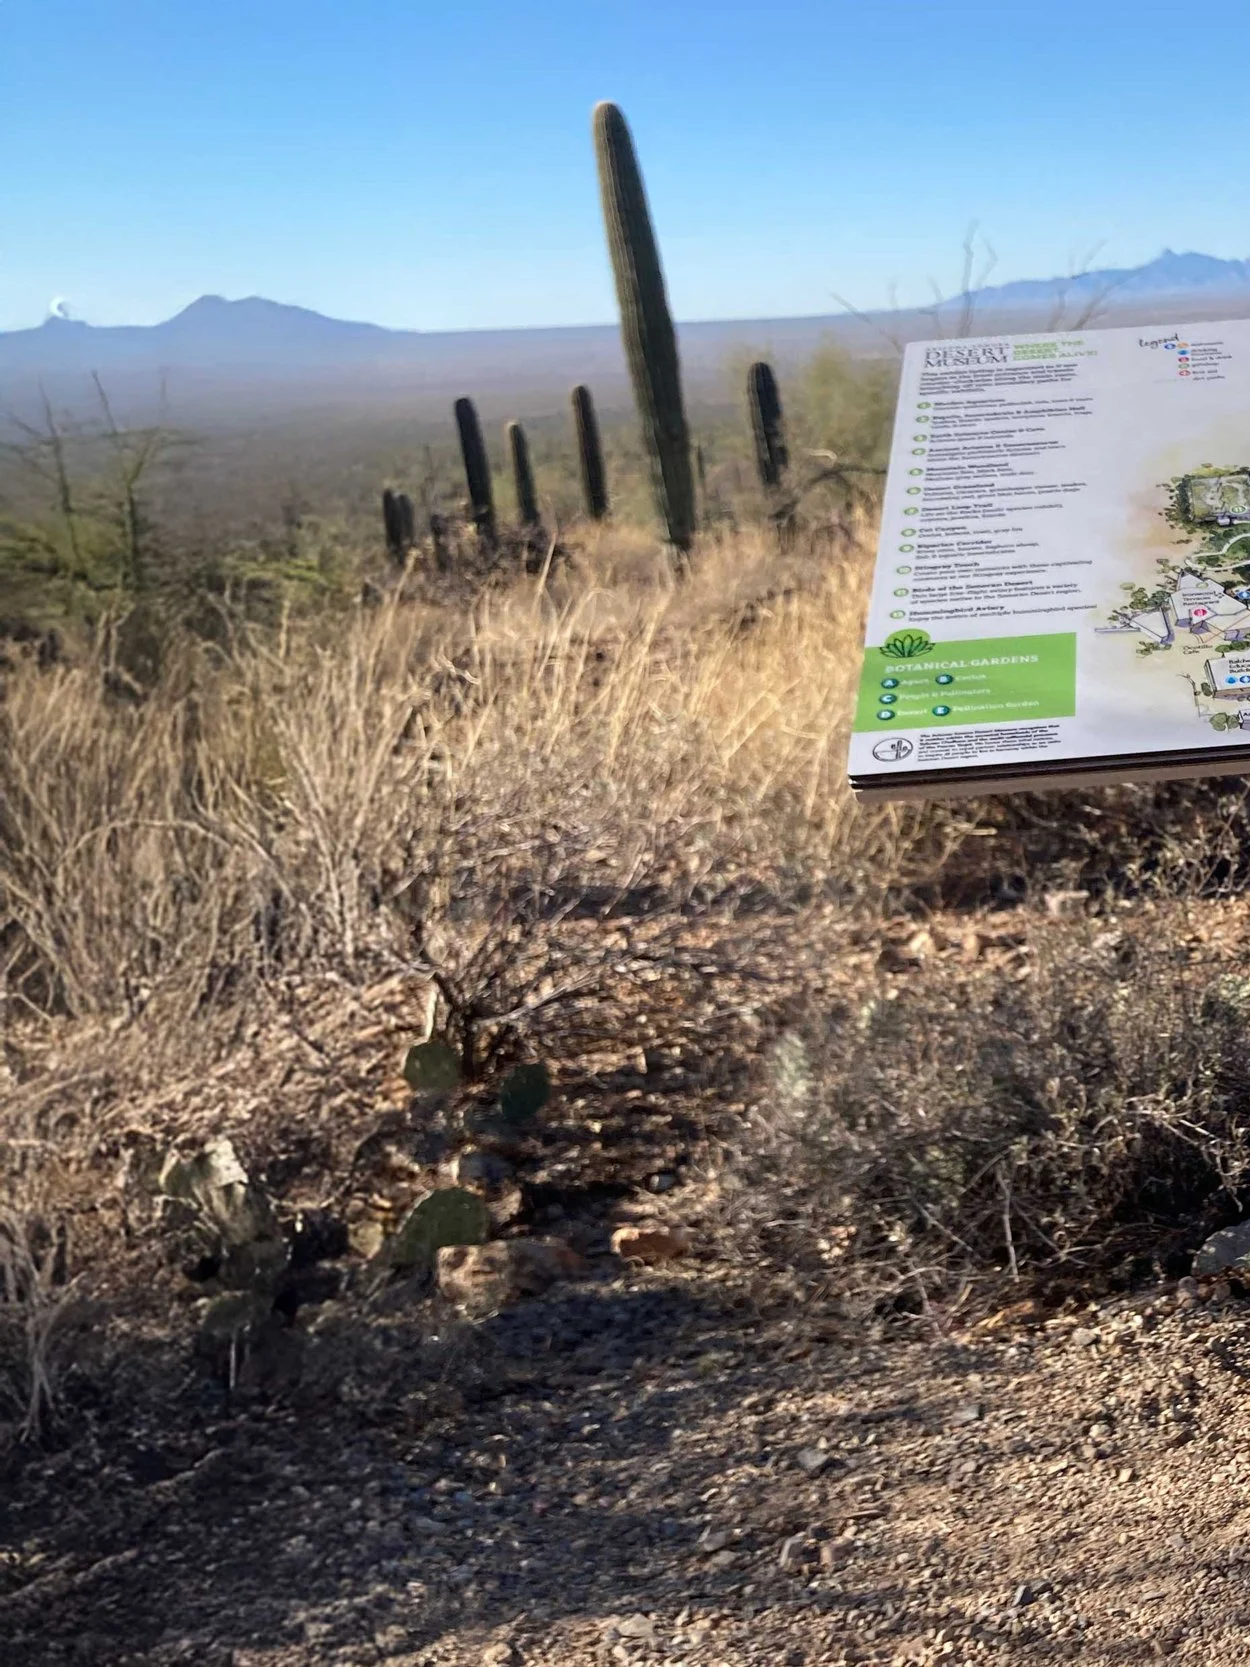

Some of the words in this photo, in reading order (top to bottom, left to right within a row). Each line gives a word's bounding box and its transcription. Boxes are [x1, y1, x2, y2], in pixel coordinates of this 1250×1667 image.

[1138, 333, 1179, 349] legend
[925, 347, 1005, 359] DESERT
[925, 356, 1008, 368] MUSEUM
[885, 660, 968, 674] BOTANICAL
[970, 655, 1039, 667] GARDENS
